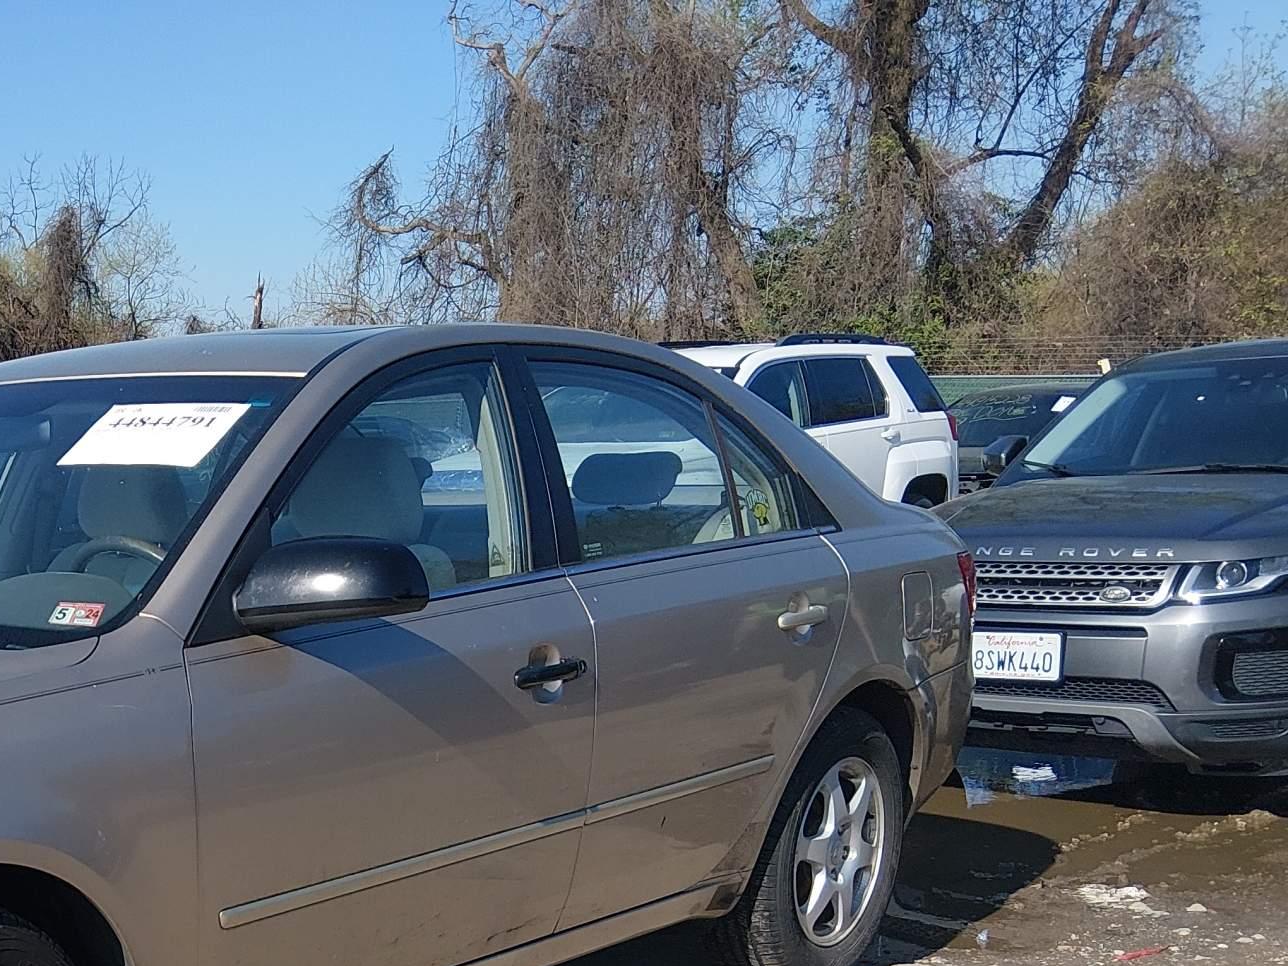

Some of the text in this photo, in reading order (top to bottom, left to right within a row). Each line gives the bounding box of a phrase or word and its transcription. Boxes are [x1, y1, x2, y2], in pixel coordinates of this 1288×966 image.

[109, 416, 216, 428] 44844791
[975, 547, 1175, 557] NGE ROVER
[55, 608, 100, 620] 5 24
[987, 635, 1039, 649] California
[974, 649, 1053, 673] 8SWK440
